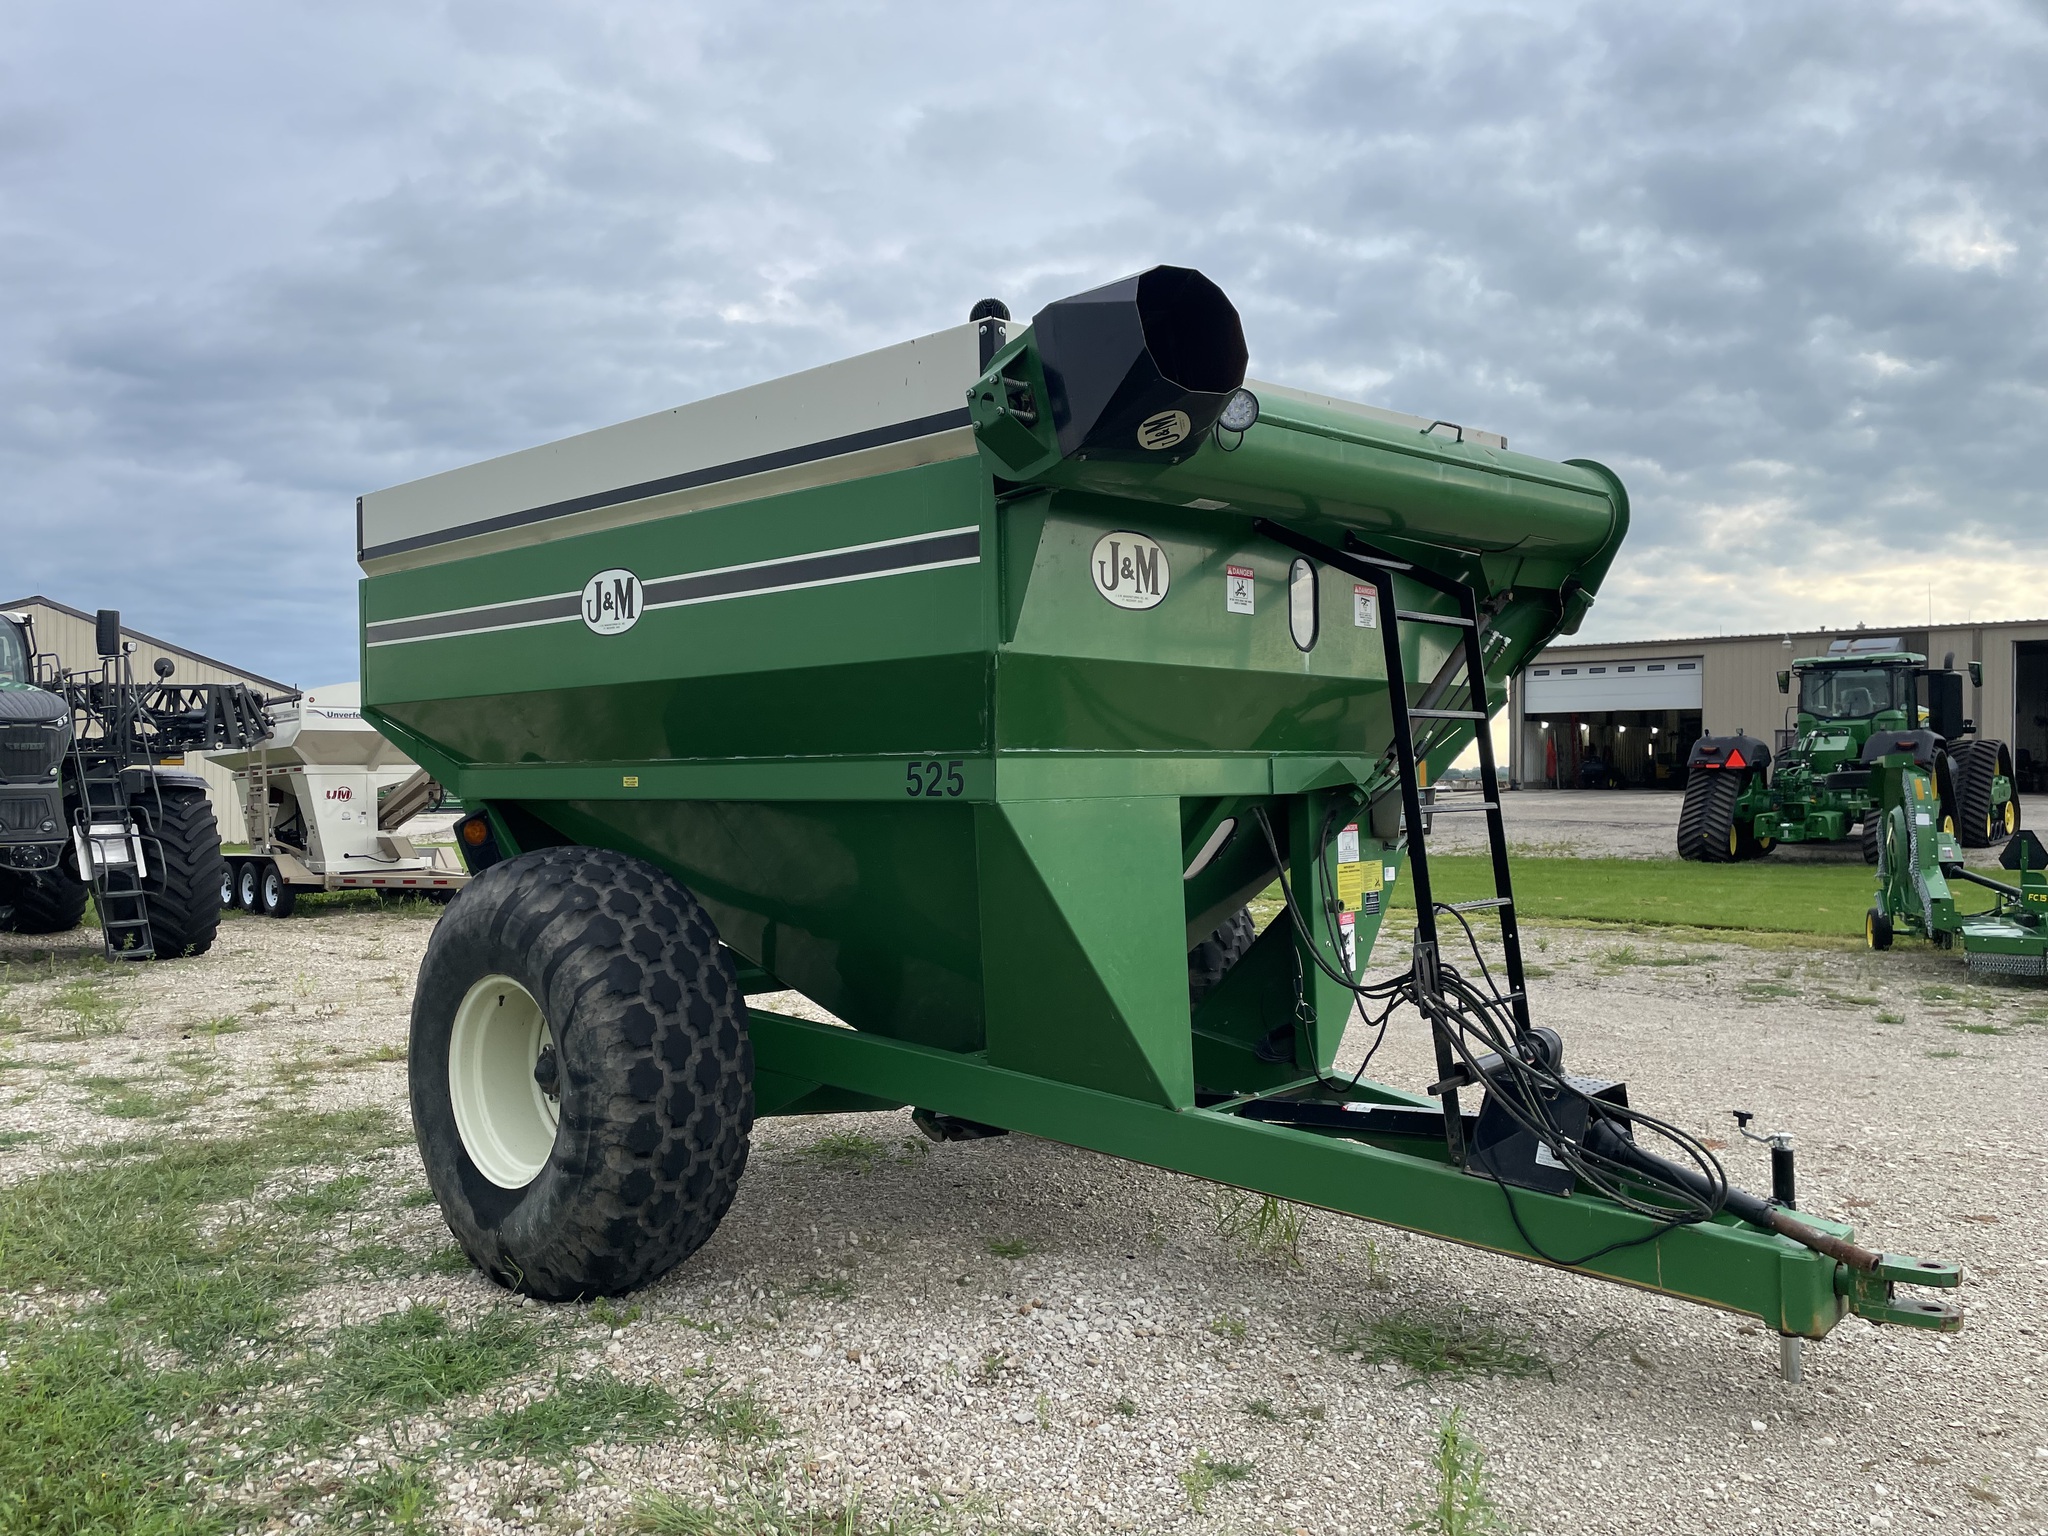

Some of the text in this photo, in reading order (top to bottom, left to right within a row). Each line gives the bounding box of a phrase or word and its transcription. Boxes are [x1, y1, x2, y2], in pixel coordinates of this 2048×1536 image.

[1143, 412, 1180, 447] J&M
[1098, 541, 1160, 595] J&M
[1232, 569, 1253, 578] DANGER
[586, 577, 635, 623] J&M
[906, 761, 964, 797] 525
